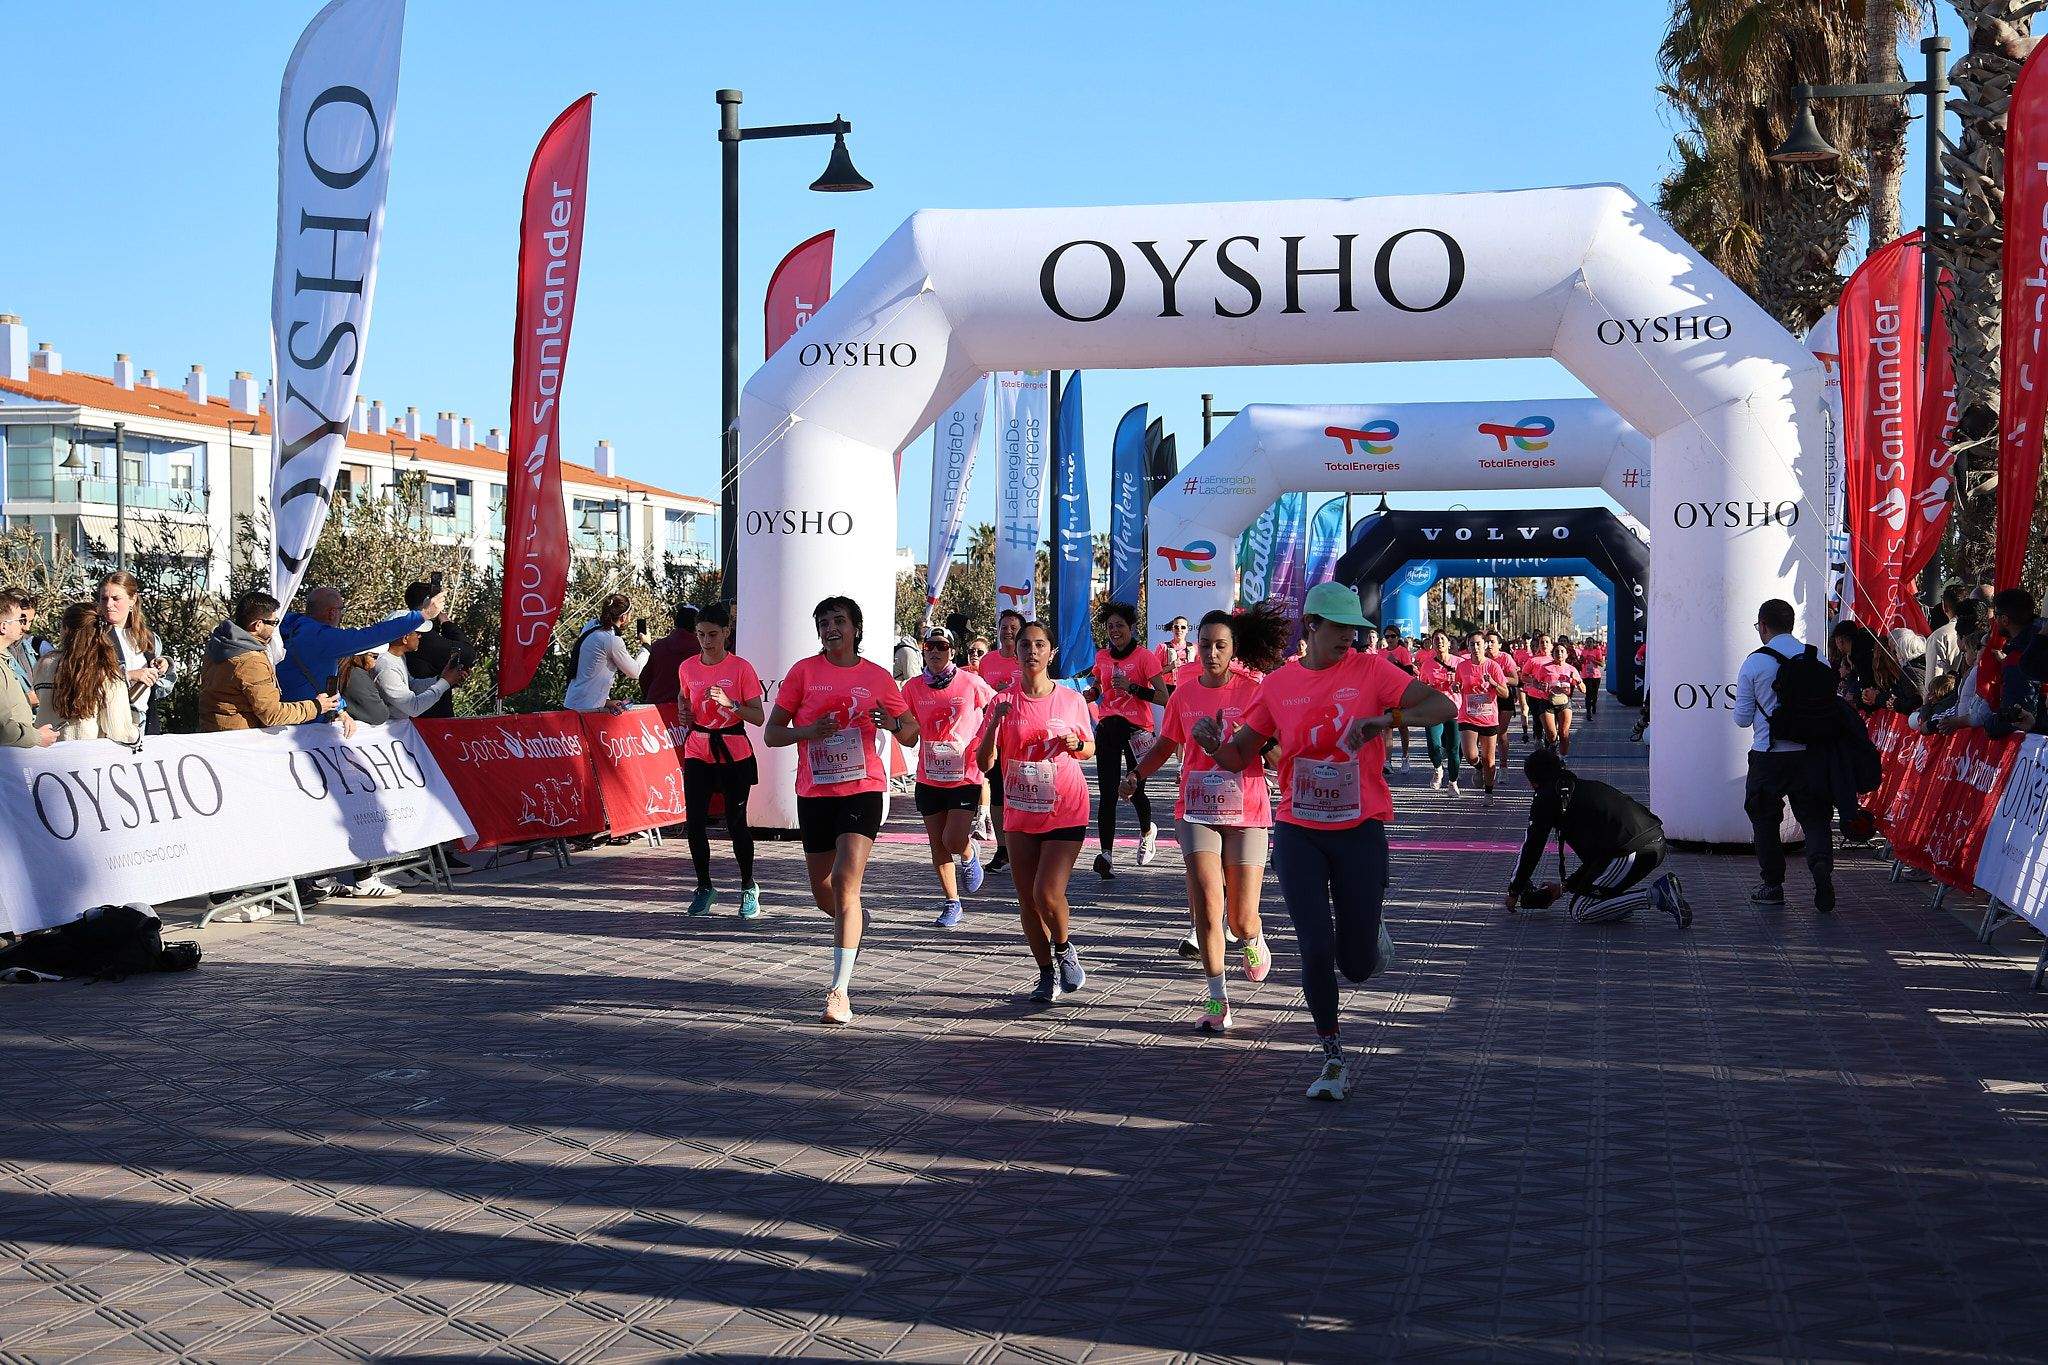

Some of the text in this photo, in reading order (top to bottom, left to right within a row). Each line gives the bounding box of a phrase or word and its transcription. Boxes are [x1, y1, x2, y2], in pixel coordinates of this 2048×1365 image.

[1039, 228, 1465, 322] OYSHO
[533, 181, 573, 425] Santander
[1597, 315, 1732, 345] OYSHO
[799, 342, 917, 367] OYSHO
[1869, 299, 1905, 481] Santander
[1325, 461, 1400, 472] TotalEnergies
[1478, 457, 1556, 469] TotalEnergies
[746, 510, 853, 536] OYSHO
[1112, 471, 1143, 572] Marlene
[1674, 500, 1800, 529] OYSHO
[1421, 526, 1570, 541] VOLVO
[1156, 578, 1217, 588] TotalEnergies
[1673, 683, 1738, 709] OYS
[518, 731, 583, 758] Santander
[600, 730, 645, 766] Sports
[826, 752, 848, 763] 016
[288, 740, 426, 800] OYSHO
[934, 759, 951, 767] 016
[32, 754, 223, 840] OYSHO
[1020, 783, 1039, 793] 016
[1203, 794, 1225, 804] 016
[1314, 788, 1340, 799] 016
[105, 843, 189, 870] WWW.OYSHO.COM
